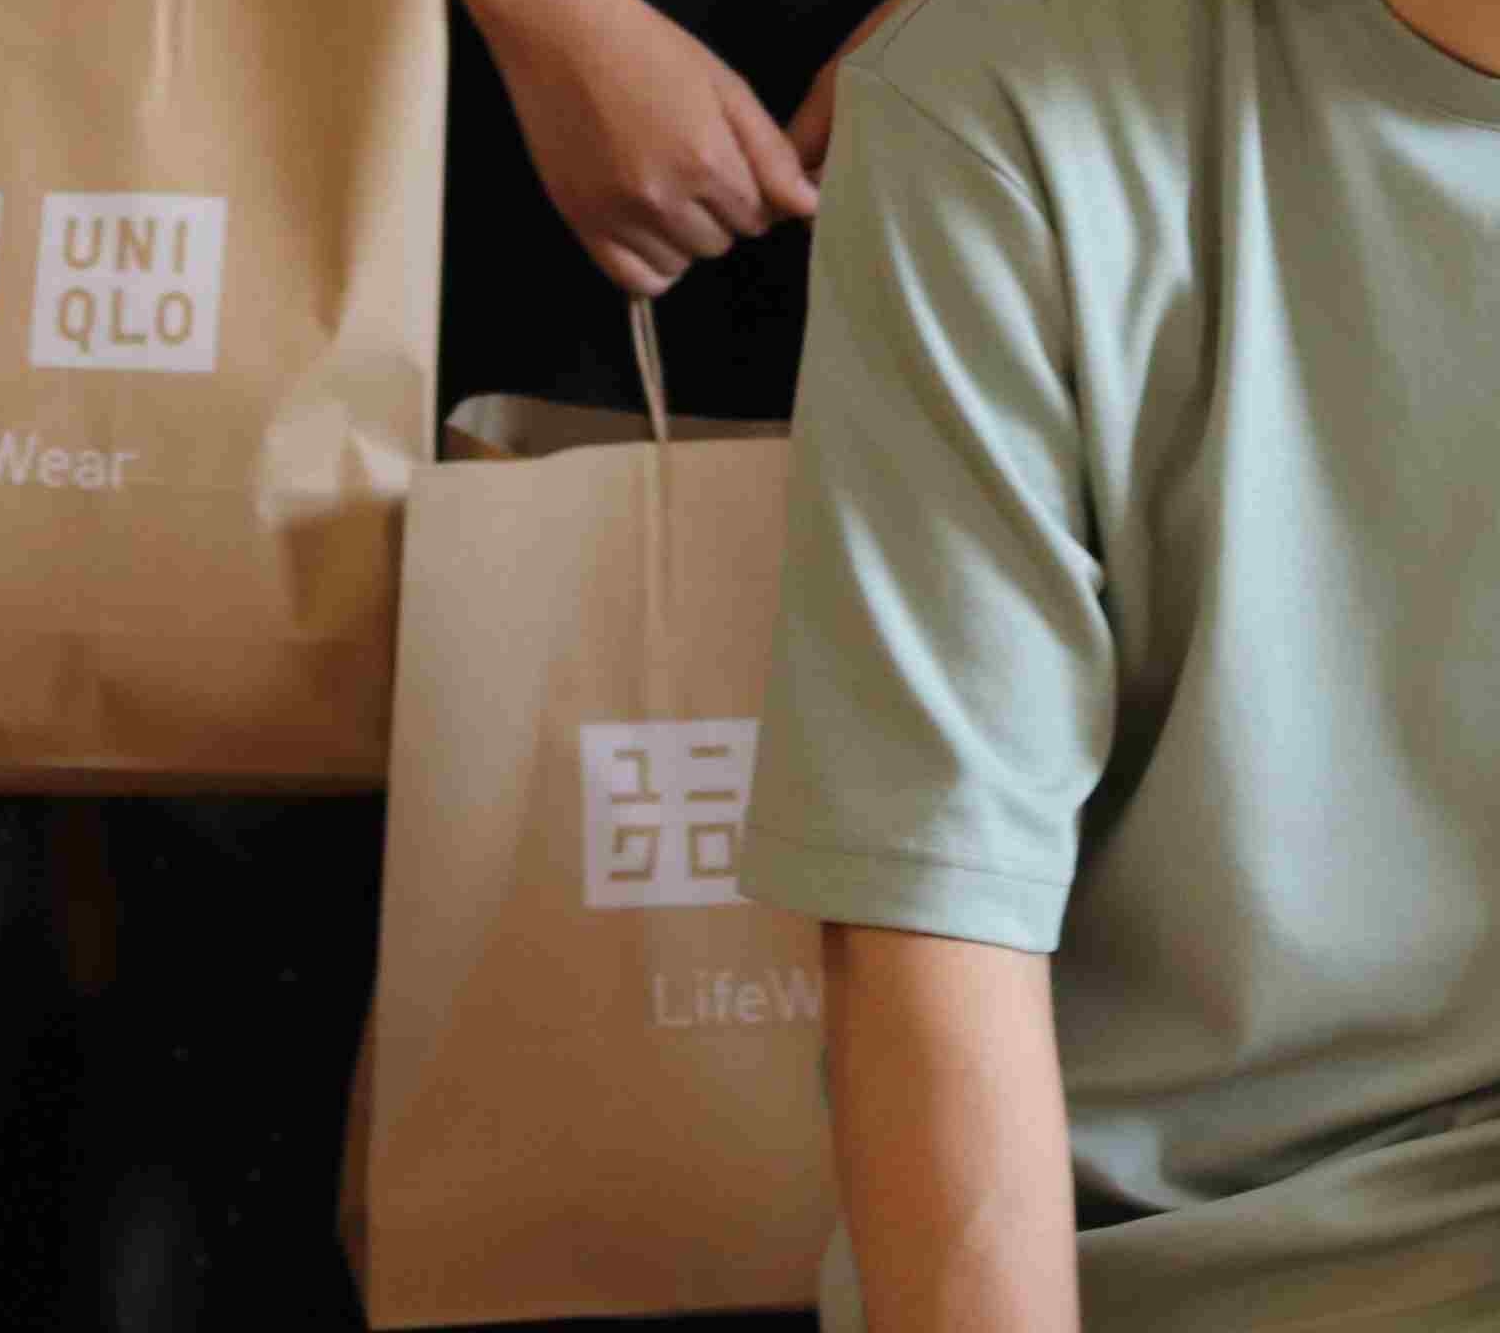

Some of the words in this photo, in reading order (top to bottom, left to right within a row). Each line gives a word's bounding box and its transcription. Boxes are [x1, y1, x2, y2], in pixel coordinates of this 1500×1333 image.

[62, 216, 188, 275] UNI
[56, 288, 195, 354] QLO
[608, 744, 739, 805] ユニ
